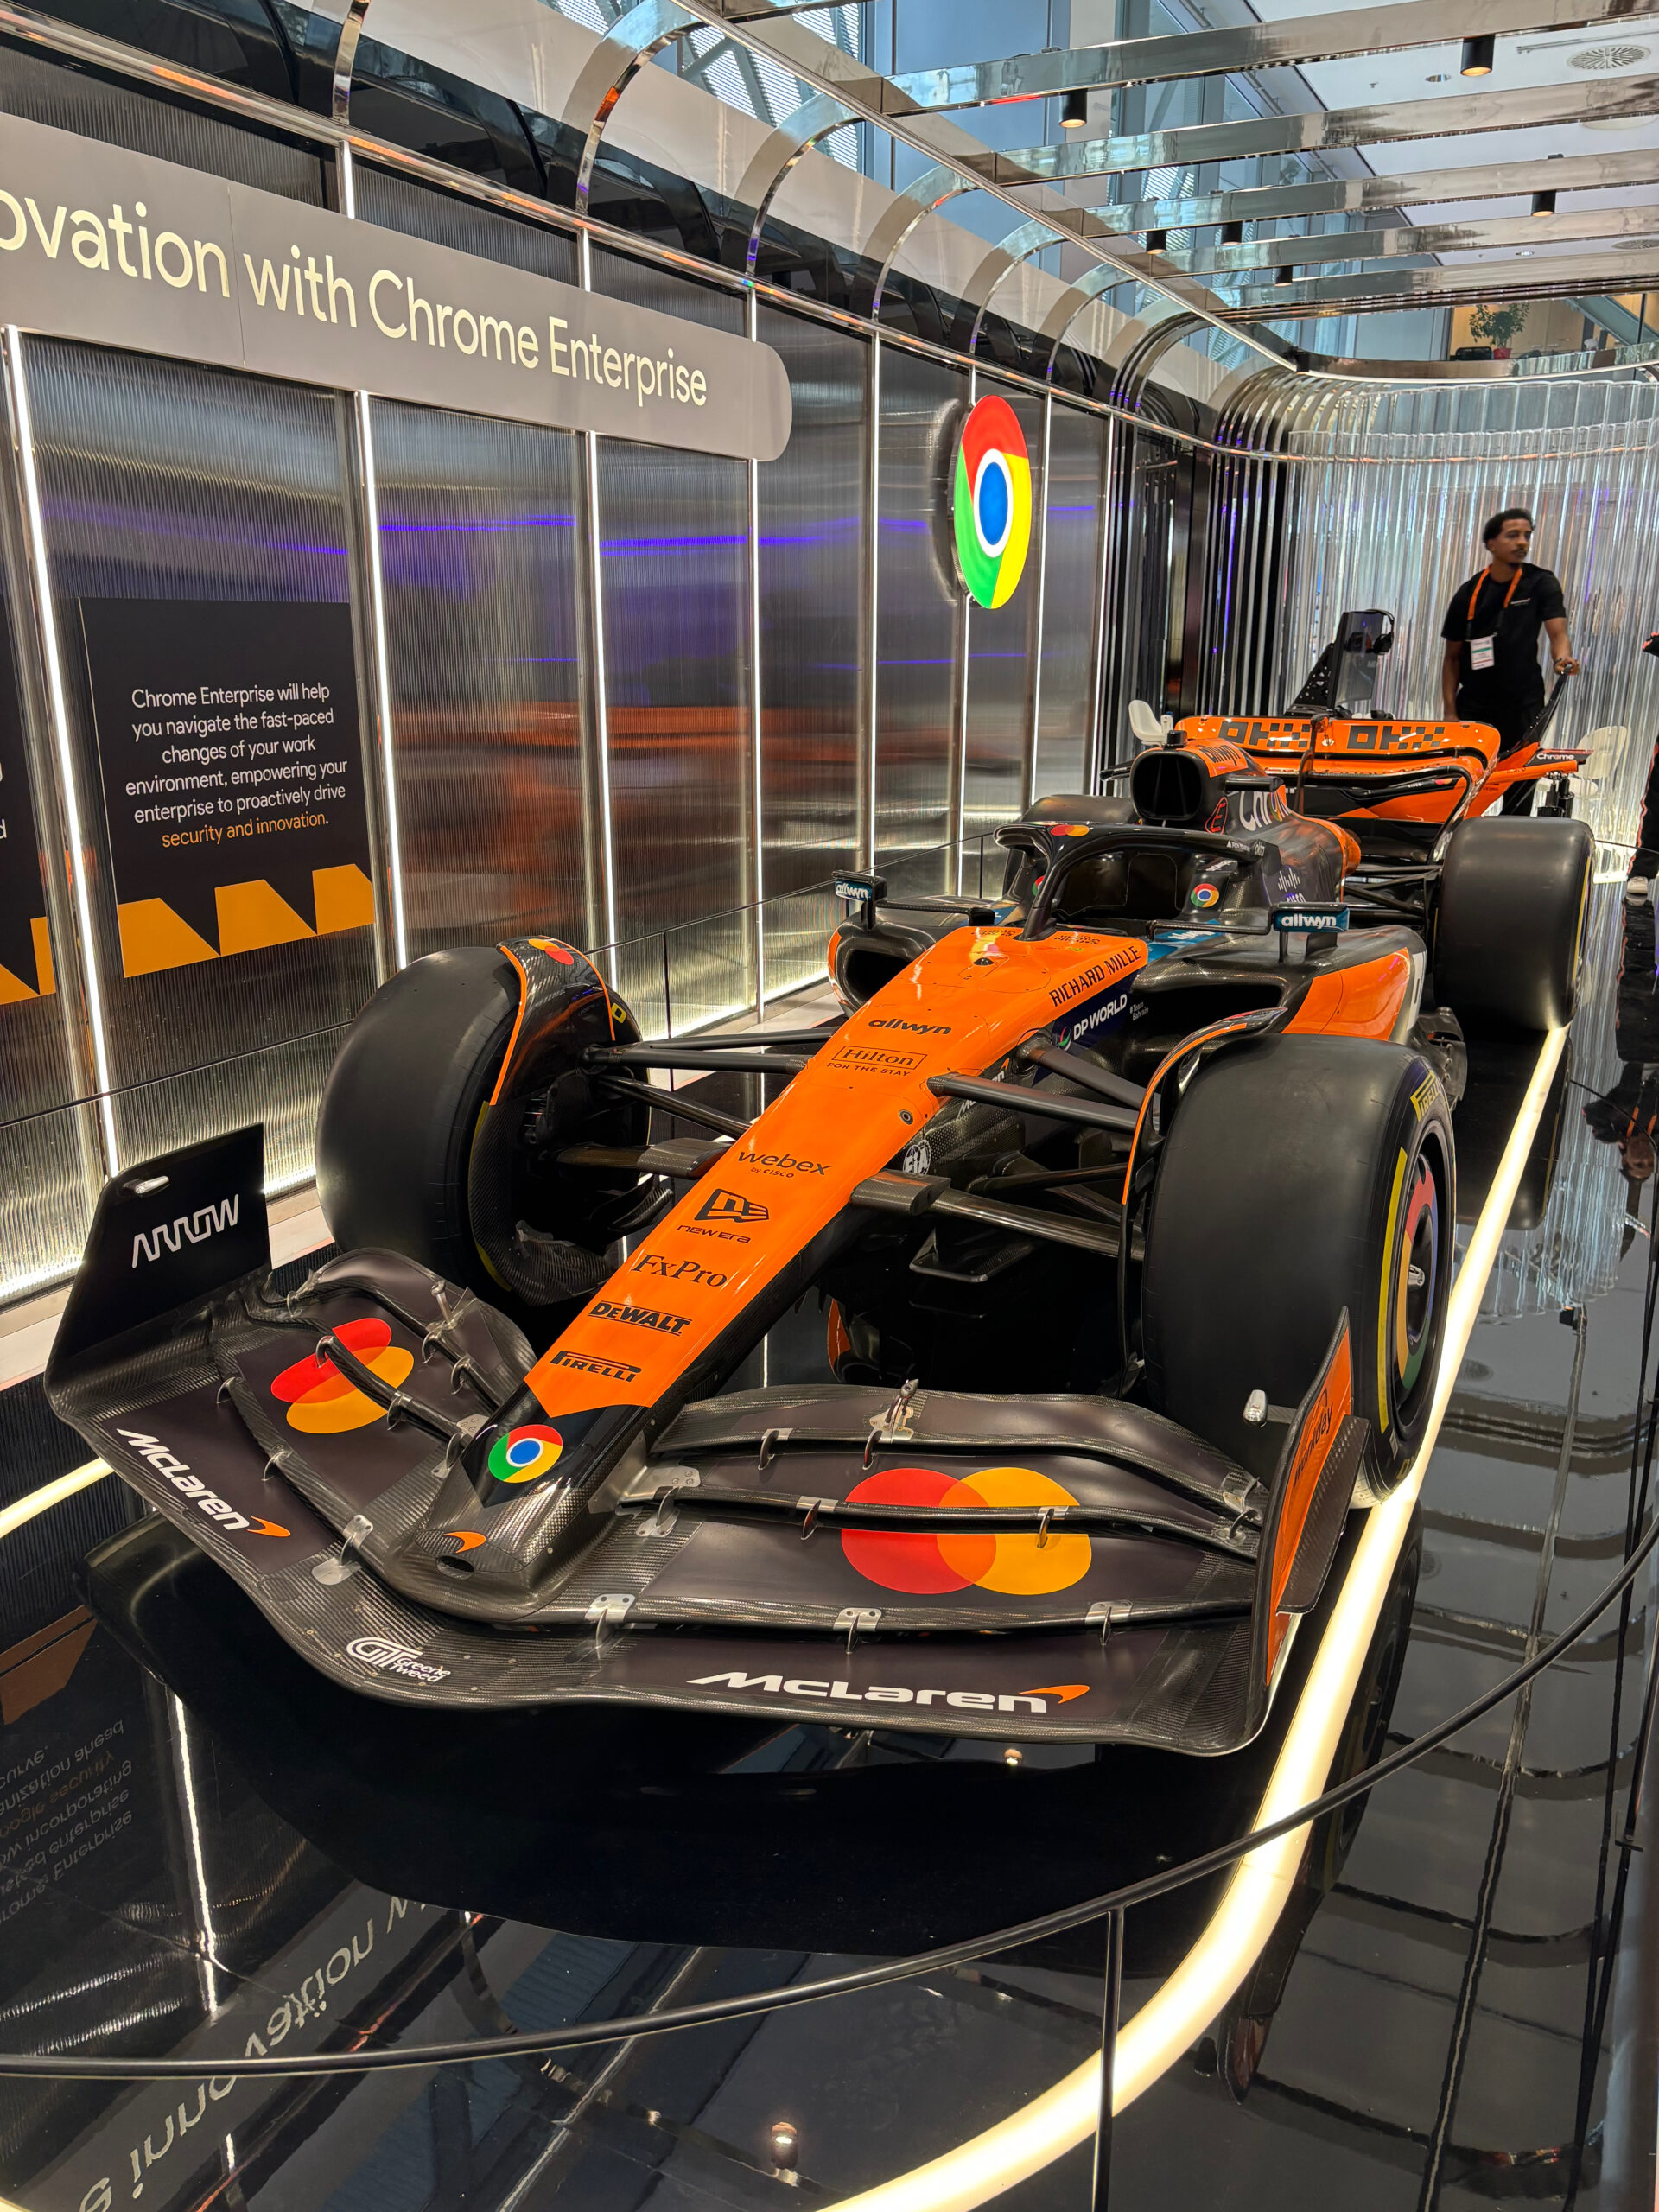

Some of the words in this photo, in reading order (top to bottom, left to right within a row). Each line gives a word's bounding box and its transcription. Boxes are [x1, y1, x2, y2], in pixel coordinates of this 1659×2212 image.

[244, 245, 357, 328] with
[368, 270, 539, 370] Chrome
[550, 317, 708, 408] Enterprise
[131, 687, 197, 708] Chrome
[200, 684, 275, 708] Enterprise
[276, 683, 299, 701] will
[302, 682, 330, 703] help
[131, 721, 162, 742] you
[166, 715, 232, 738] navigate
[234, 712, 257, 730] the
[260, 708, 334, 731] fast-paced
[162, 742, 226, 765] changes
[230, 740, 245, 758] of
[249, 740, 278, 760] your
[282, 735, 316, 753] work
[125, 772, 228, 796] environment,
[231, 764, 317, 786] empowering
[319, 760, 347, 781] your
[134, 799, 214, 823] enterprise
[218, 796, 233, 813] to
[236, 786, 311, 816] proactively
[314, 784, 346, 802] drive
[162, 823, 222, 849] security
[226, 819, 253, 839] and
[257, 811, 329, 835] innovation.
[1281, 912, 1337, 929] allwyn
[1048, 964, 1105, 1007] RICHARD
[1104, 945, 1141, 976] MILLE
[868, 1018, 951, 1035] allwyn
[1073, 1018, 1089, 1040] DP
[1090, 994, 1128, 1029] WORLD
[842, 1048, 914, 1065] Hilton
[854, 1065, 878, 1073] THE
[880, 1068, 911, 1077] STAY
[738, 1151, 832, 1176] webex
[631, 1254, 728, 1287] FxPro
[550, 1350, 643, 1382] PIRELLI
[117, 1427, 251, 1531] McLaren
[388, 1662, 447, 1683] Tweed
[397, 1657, 452, 1676] Greene
[686, 1671, 1048, 1713] McLaren
